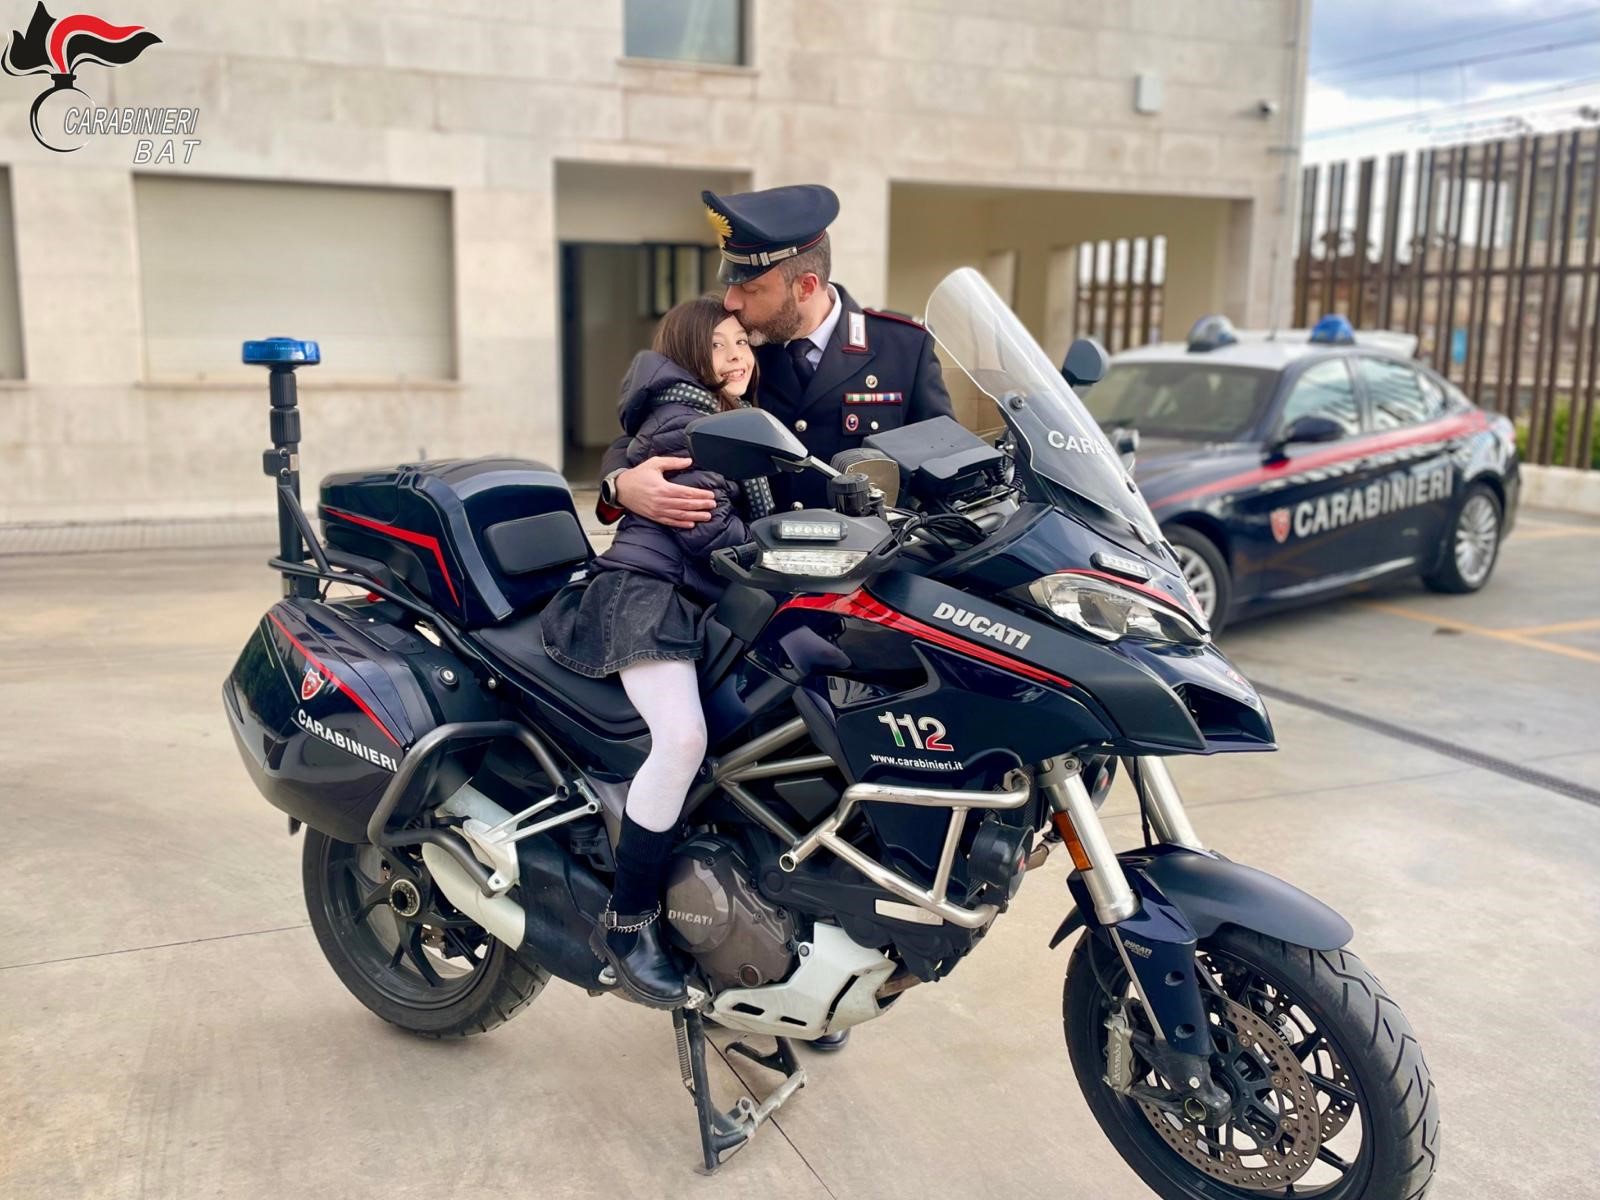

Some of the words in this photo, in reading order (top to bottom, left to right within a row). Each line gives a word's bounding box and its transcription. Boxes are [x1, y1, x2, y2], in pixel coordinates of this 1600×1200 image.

[1047, 430, 1109, 455] CARA
[1293, 466, 1454, 538] CARABINIERI
[932, 602, 1031, 650] DUCATI
[298, 708, 398, 773] CARABINIERI
[877, 711, 954, 752] 112
[870, 753, 964, 771] www.carabinieri.it
[668, 909, 713, 926] DUCATI
